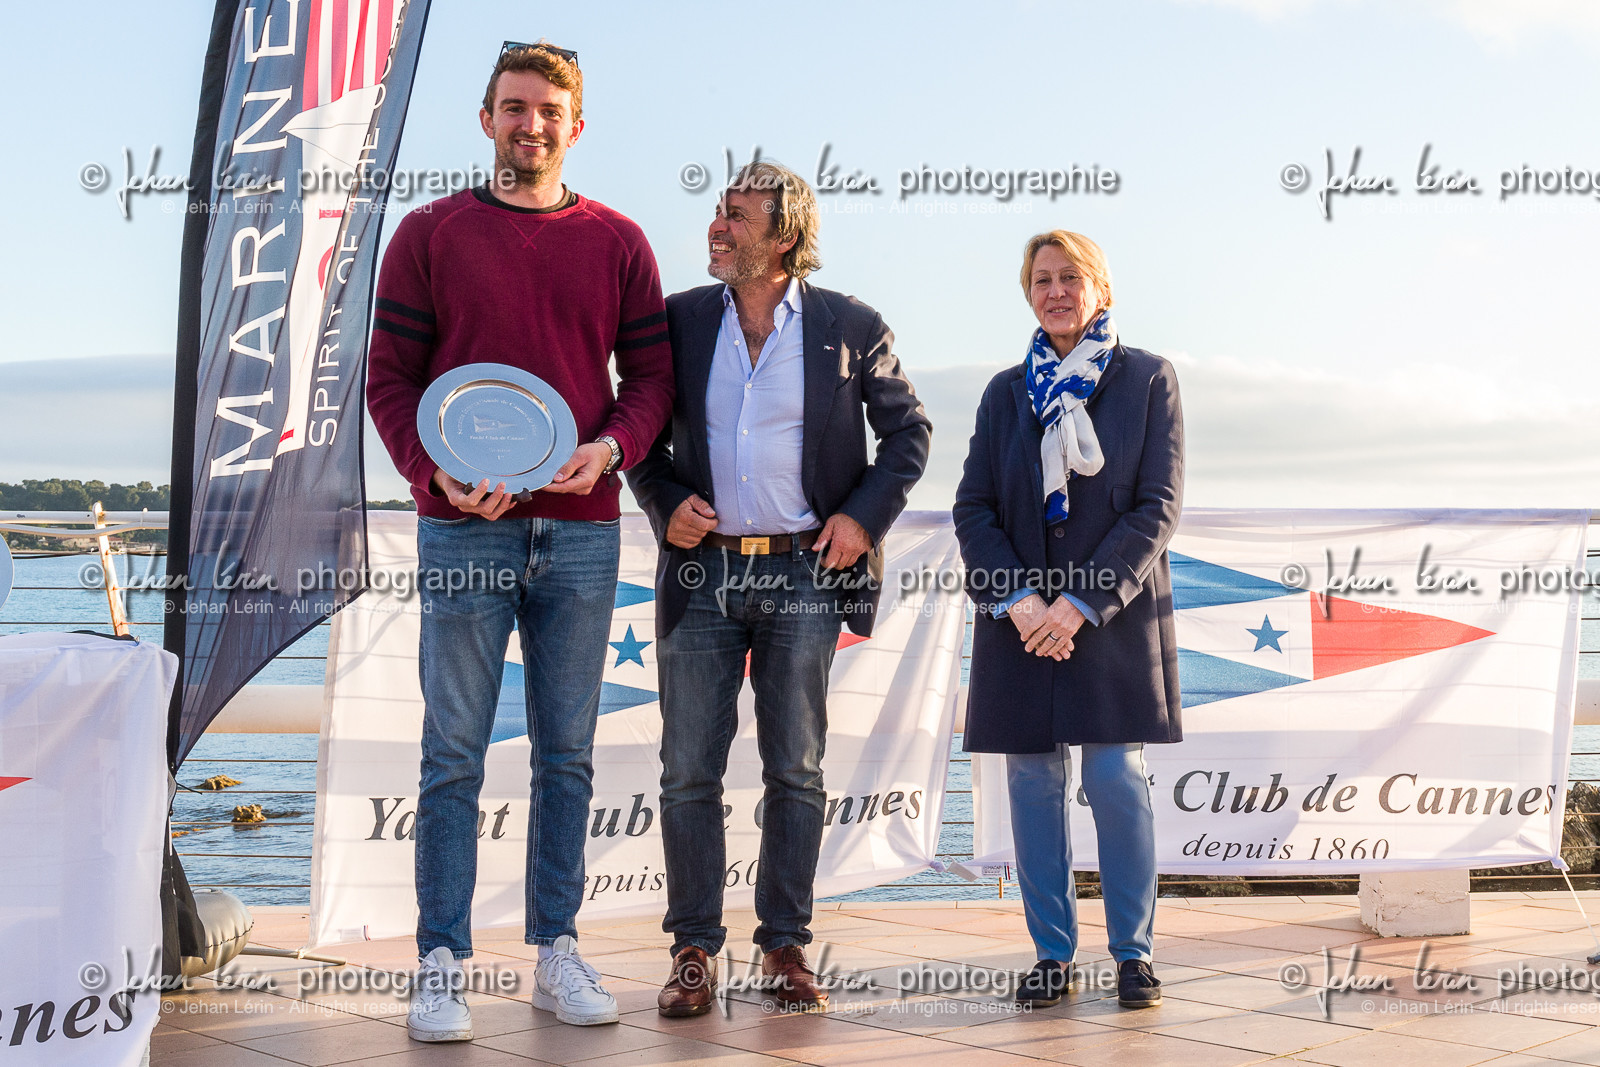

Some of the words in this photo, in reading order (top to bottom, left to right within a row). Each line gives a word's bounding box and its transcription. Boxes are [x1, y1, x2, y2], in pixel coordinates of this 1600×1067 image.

[308, 303, 343, 447] SPIRIT
[1173, 770, 1289, 814] Club
[1301, 773, 1358, 813] de
[1378, 773, 1557, 816] Cannes
[1181, 832, 1294, 862] depuis
[1307, 837, 1390, 860] 1860
